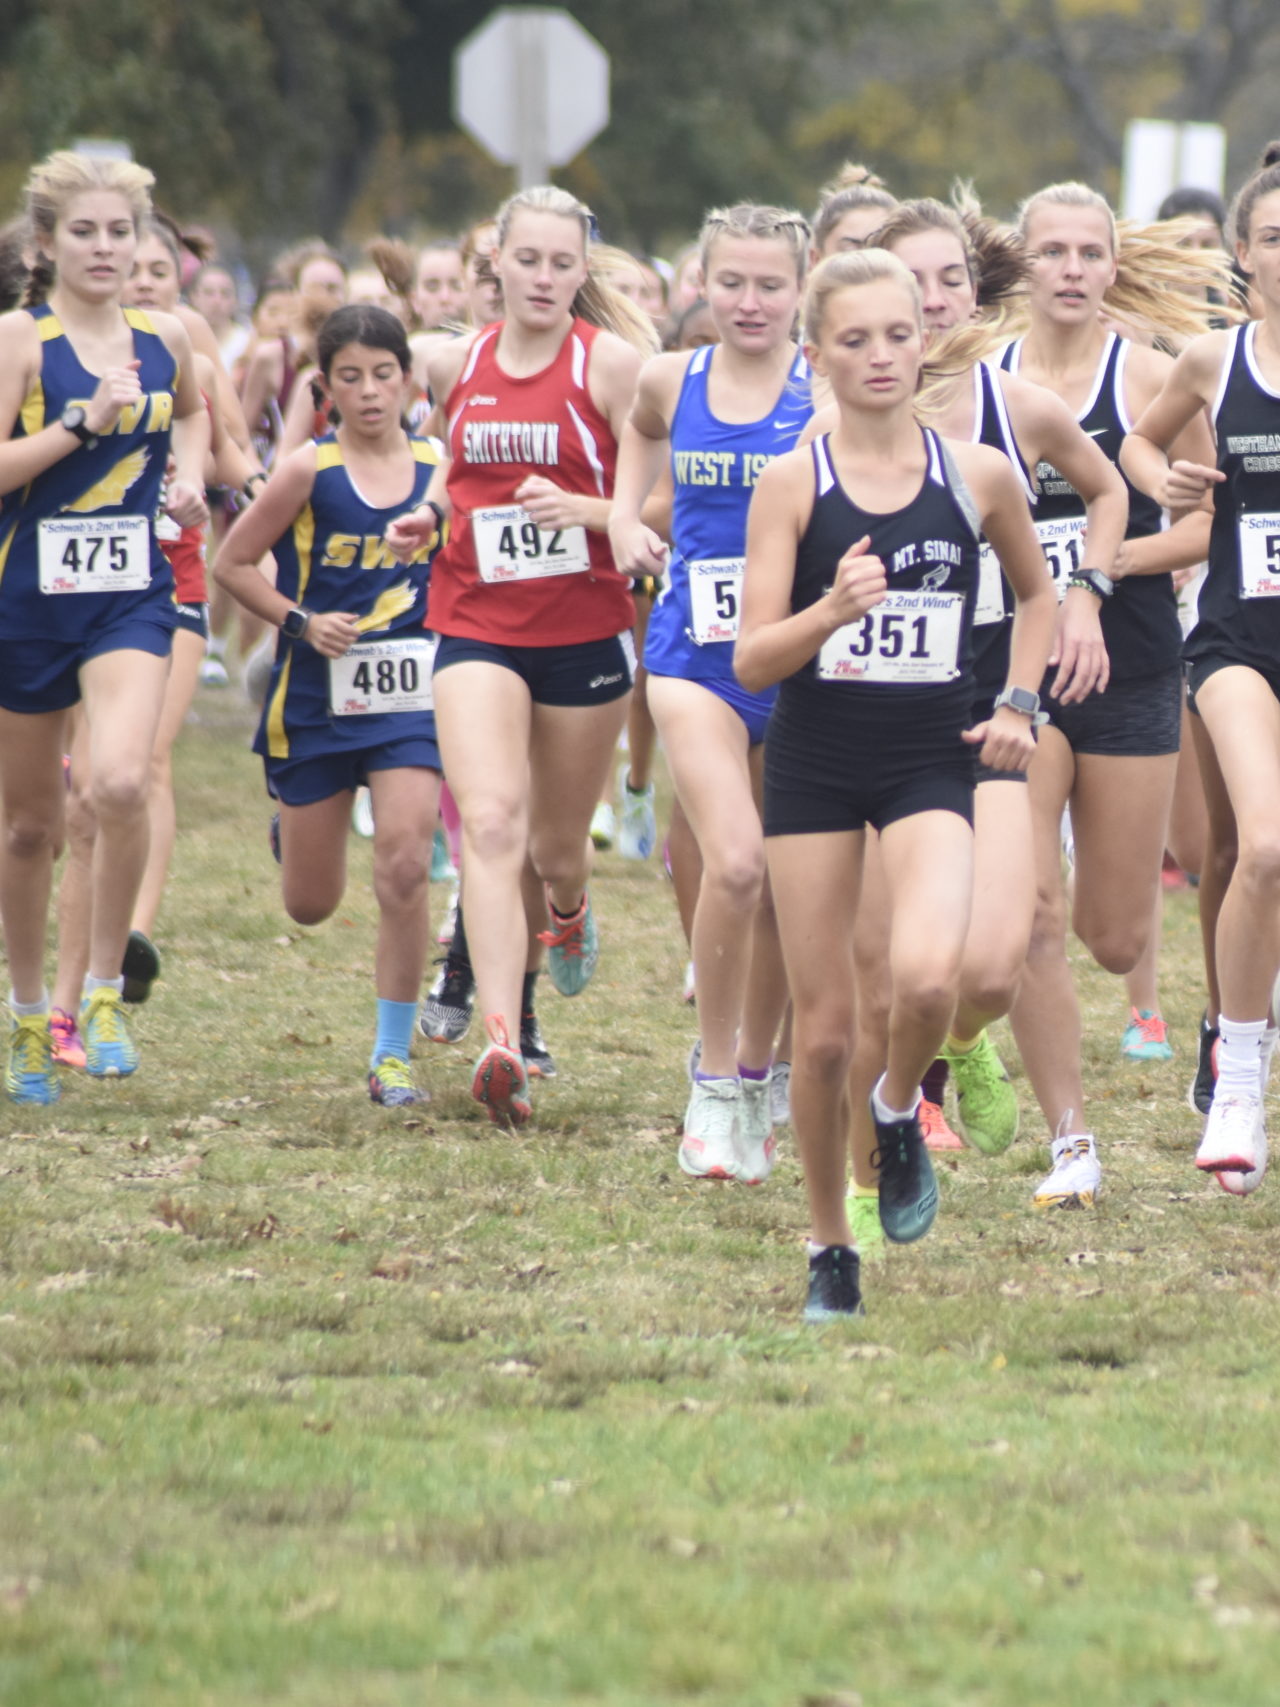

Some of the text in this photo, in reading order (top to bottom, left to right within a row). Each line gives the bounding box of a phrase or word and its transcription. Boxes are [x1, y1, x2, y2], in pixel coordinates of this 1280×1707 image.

[464, 421, 559, 465] SMITHTOWN
[675, 451, 736, 486] WEST
[499, 523, 567, 560] 492
[1048, 523, 1067, 536] 2nd
[62, 536, 127, 573] 475
[893, 540, 961, 573] MT. SINAI
[714, 580, 737, 619] 5
[895, 596, 919, 608] 2nd
[922, 597, 954, 609] Wind
[344, 646, 384, 657] chwab's
[849, 613, 930, 658] 351
[353, 658, 419, 695] 480
